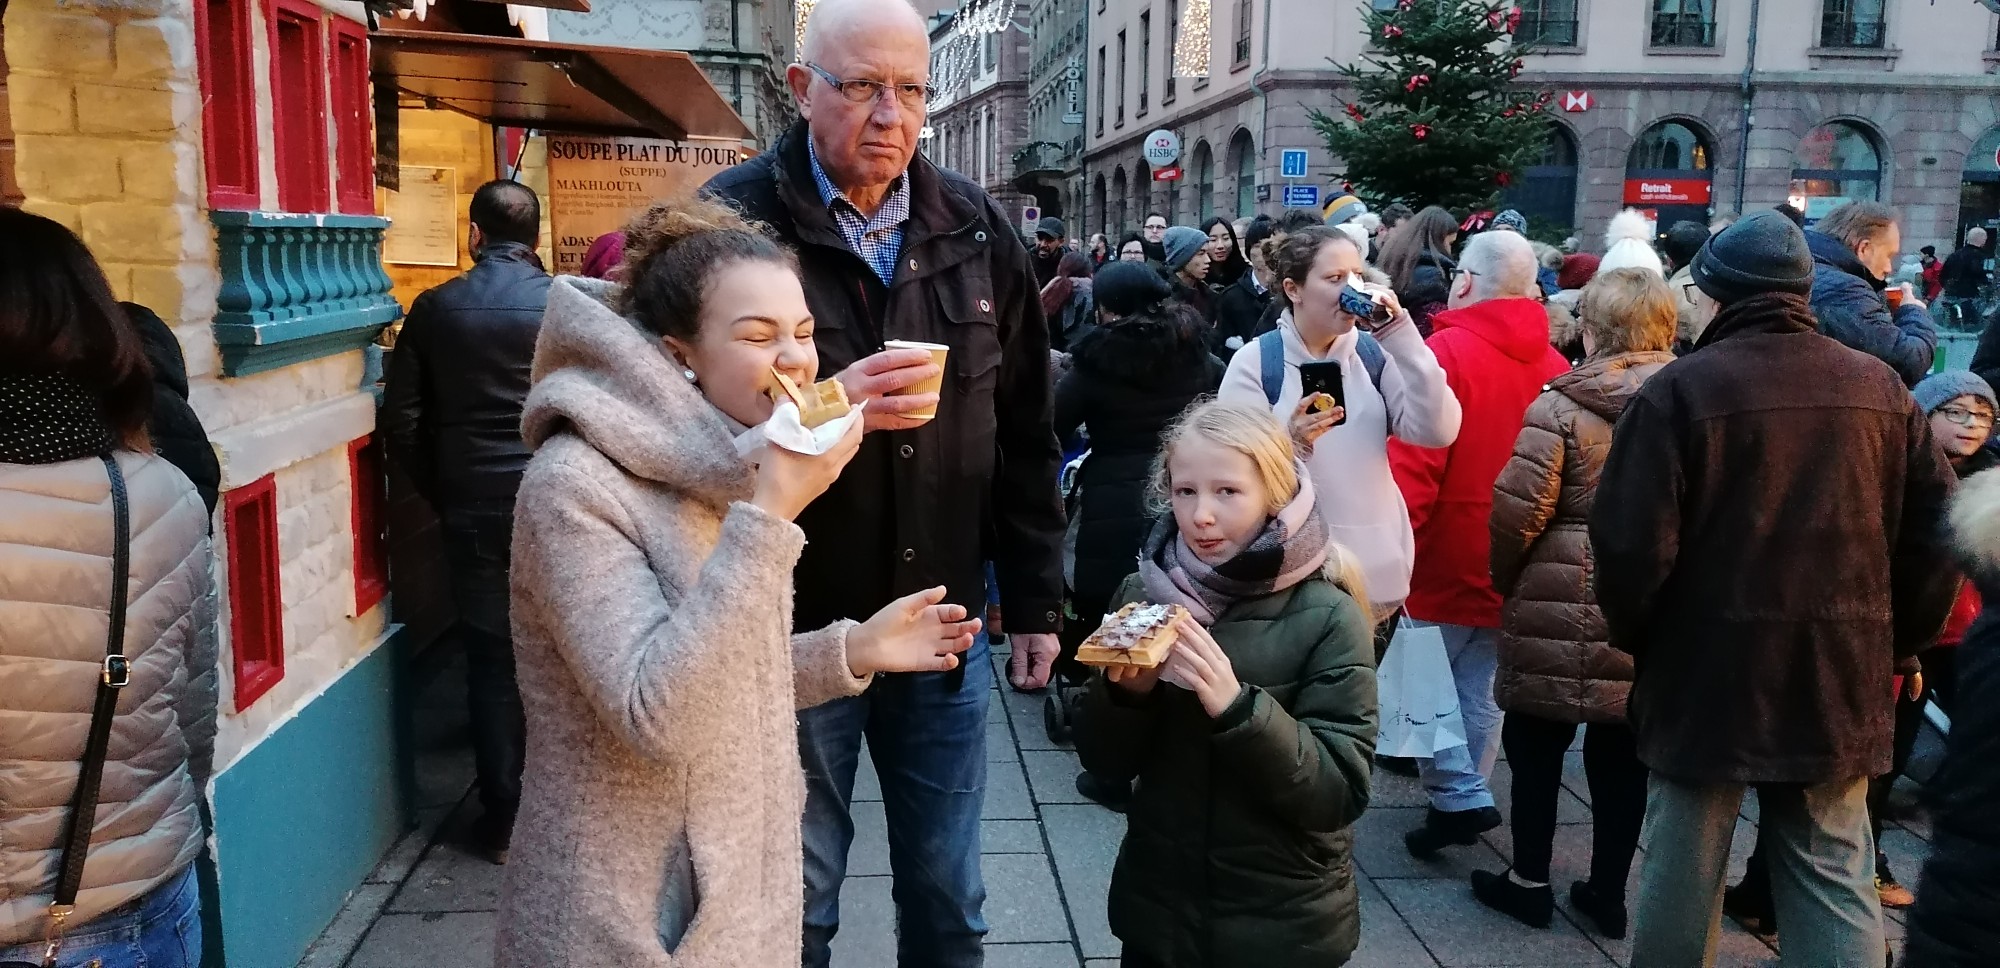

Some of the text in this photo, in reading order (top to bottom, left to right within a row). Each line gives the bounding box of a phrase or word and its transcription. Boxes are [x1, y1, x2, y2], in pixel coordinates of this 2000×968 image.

[552, 141, 737, 168] SOUPE PLAT DU JOUR
[1149, 148, 1177, 158] HSBC
[619, 166, 667, 178] (SUPPE)
[556, 179, 643, 193] MAKHLOUTA
[1641, 182, 1672, 193] Retrait
[559, 236, 594, 247] ADAS
[559, 252, 577, 263] ET
